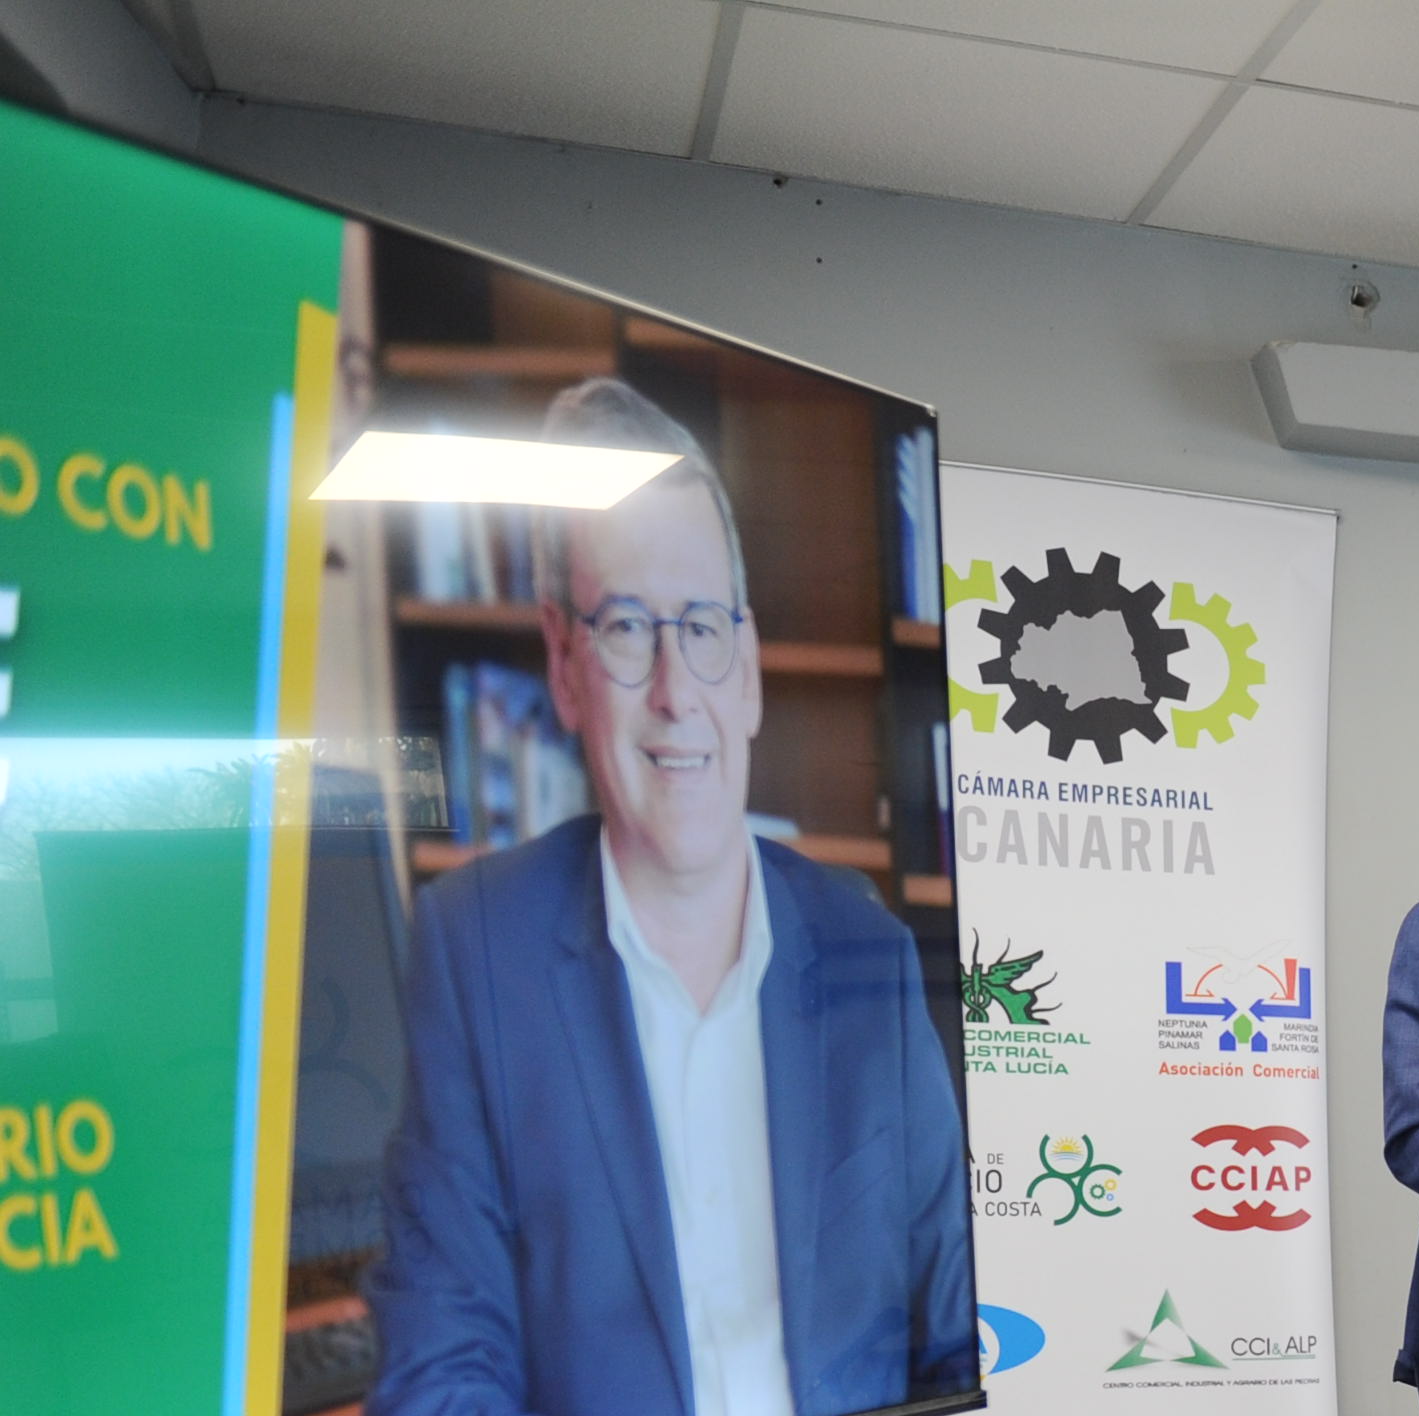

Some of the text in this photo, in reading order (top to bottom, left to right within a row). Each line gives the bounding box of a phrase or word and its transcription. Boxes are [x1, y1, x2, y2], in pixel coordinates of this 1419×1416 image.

[58, 451, 212, 553] CON
[957, 771, 1213, 811] CÁMARA EMPRESARIAL
[957, 805, 1215, 875] CANARIA
[1158, 1019, 1208, 1029] NEPTUNIA
[964, 1029, 1091, 1045] COMERCIAL
[1158, 1030, 1203, 1039] PINAMAR
[1158, 1040, 1200, 1050] SALINAS
[1006, 1060, 1069, 1075] LUCÍA
[1158, 1061, 1320, 1080] Asociación Comercial
[987, 1153, 1004, 1165] DE
[1190, 1164, 1312, 1192] CCIAP
[985, 1201, 1042, 1217] COSTA
